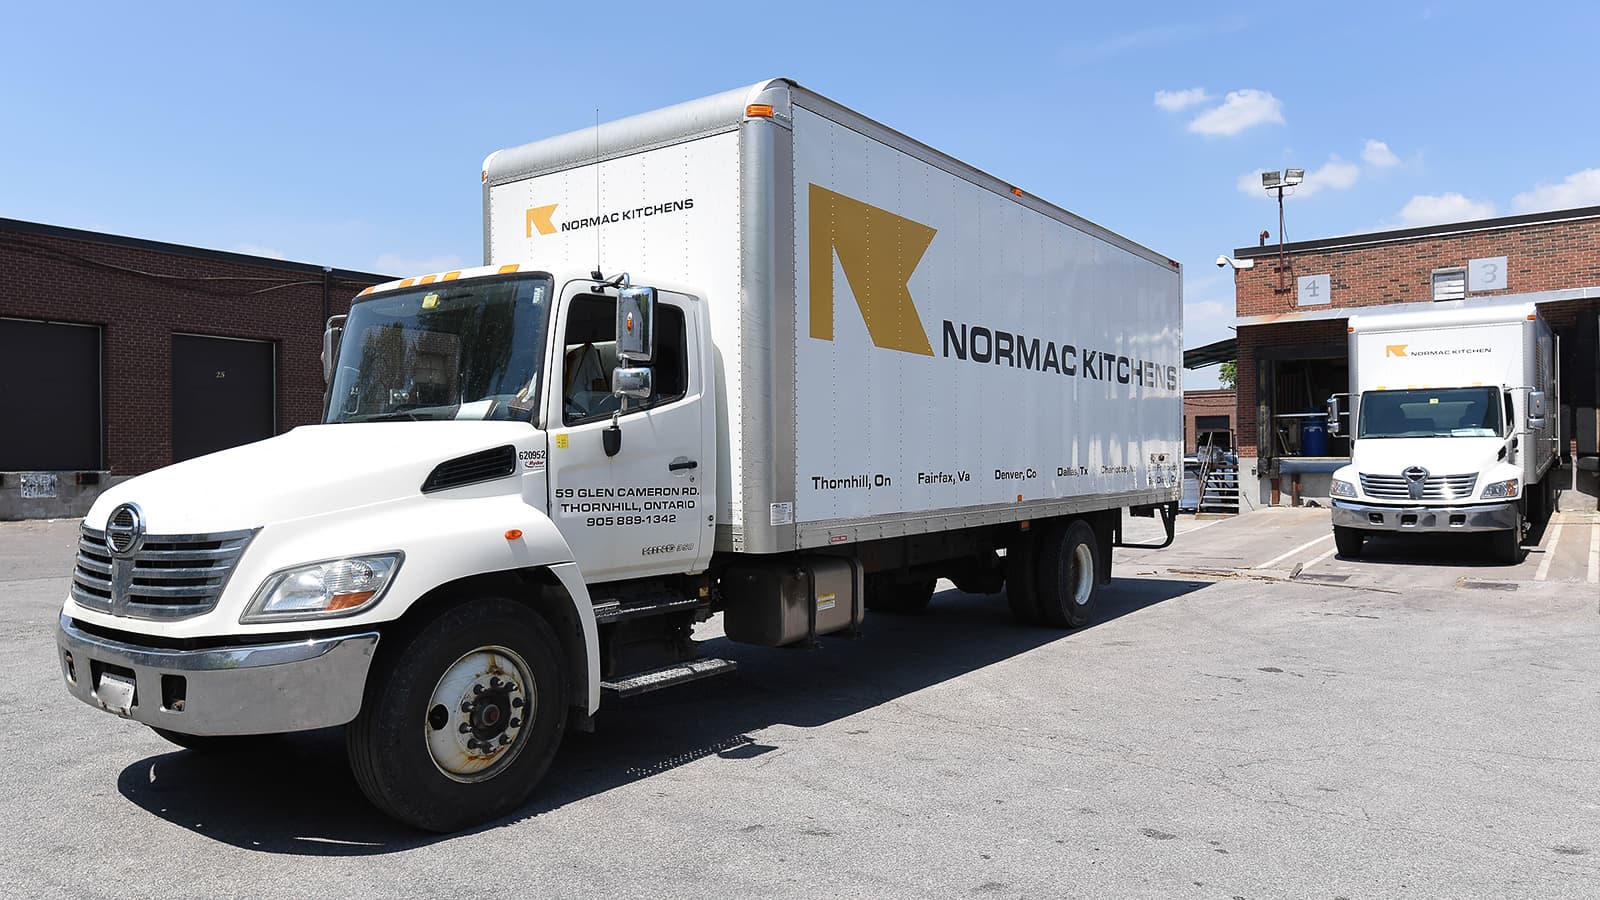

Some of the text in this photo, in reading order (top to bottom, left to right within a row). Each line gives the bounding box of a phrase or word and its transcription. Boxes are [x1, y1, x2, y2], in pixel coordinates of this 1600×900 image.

[561, 199, 694, 232] NORMAC KITCHENS
[1480, 263, 1498, 284] 3
[1305, 279, 1320, 298] 4
[943, 320, 1177, 391] NORMAC KITCHENS
[519, 450, 546, 460] 620952
[917, 470, 971, 485] Fairfax, Va
[994, 468, 1037, 481] Denver, Co
[1080, 466, 1089, 476] Tx
[811, 474, 891, 490] Thornhill, On
[555, 487, 700, 498] 59 GLEN CAMERON RD.
[561, 501, 695, 513] THORNHILL, ONTARIO
[586, 514, 677, 527] 905 889-1342
